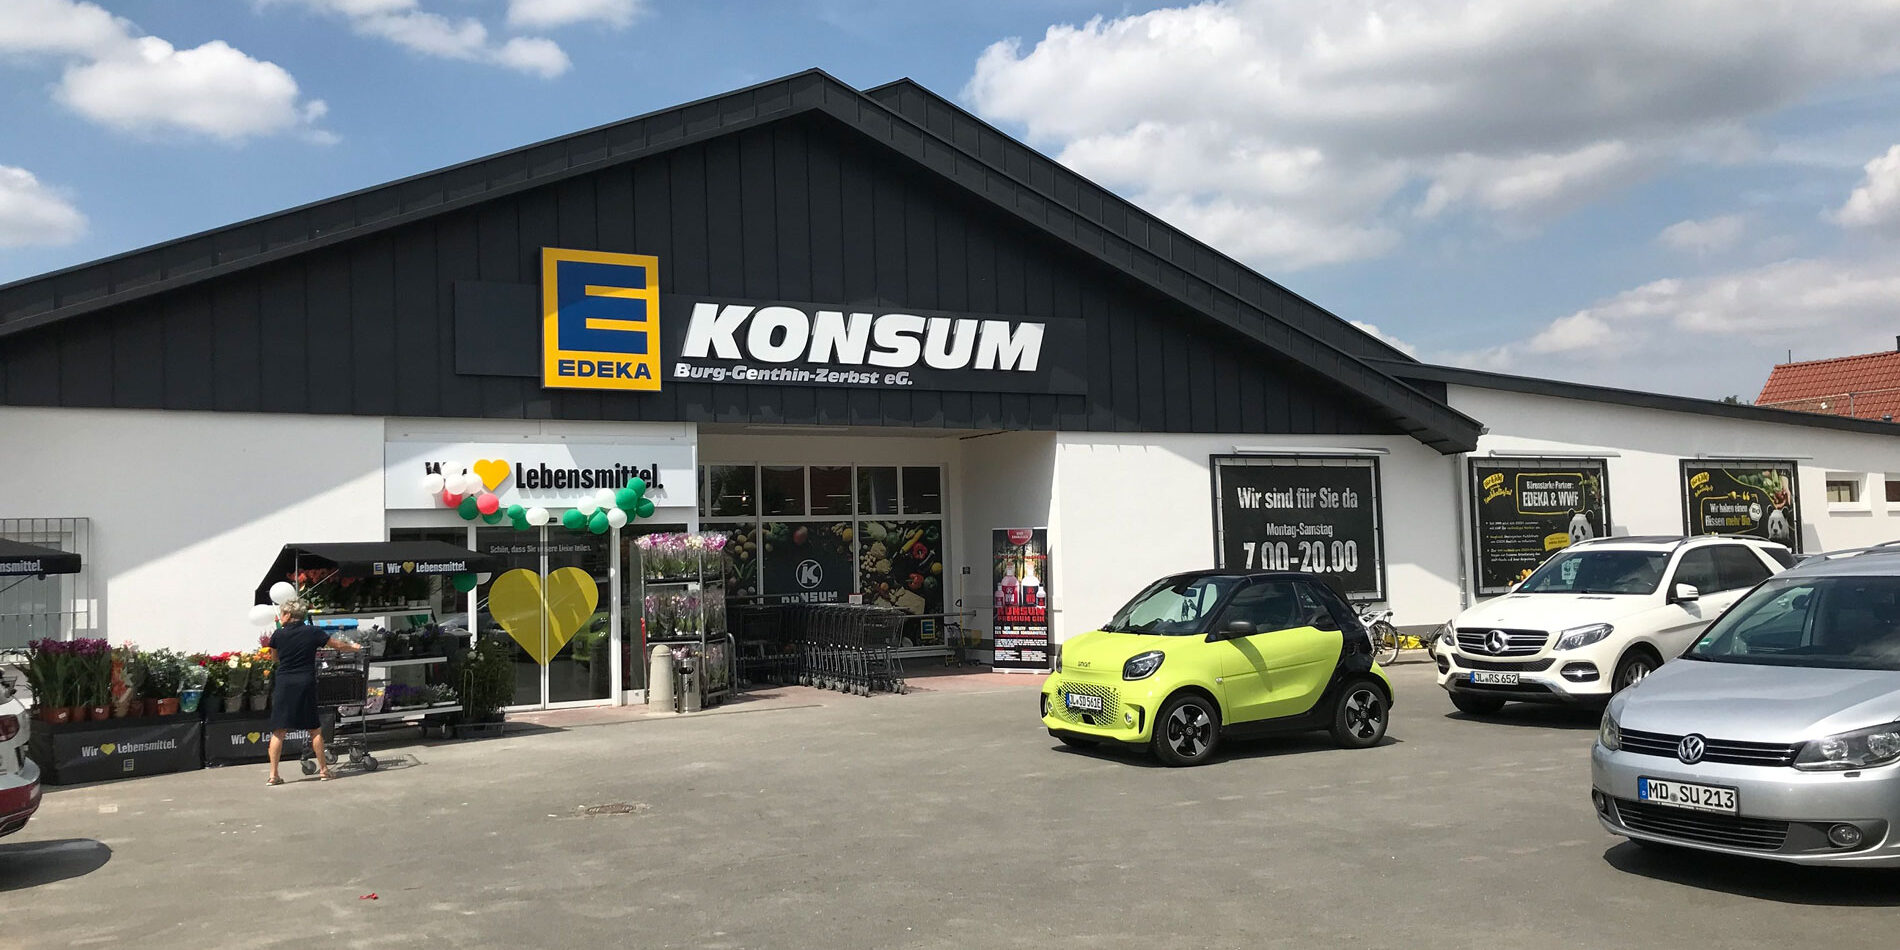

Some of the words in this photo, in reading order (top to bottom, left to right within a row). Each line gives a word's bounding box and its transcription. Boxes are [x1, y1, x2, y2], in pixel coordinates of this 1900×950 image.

[683, 303, 1046, 372] KONSUM
[557, 358, 652, 381] EDEKA
[674, 363, 880, 386] Burg-Genthin-Zerbst
[884, 372, 913, 386] eG.
[1236, 487, 1262, 509] Wir
[1264, 487, 1294, 509] sind
[1295, 487, 1317, 509] für
[1319, 487, 1340, 509] Sie
[1342, 487, 1358, 509] da
[1522, 492, 1549, 507] EDEKA
[1550, 492, 1557, 507] &
[1558, 491, 1579, 507] WWF
[1709, 503, 1719, 513] Wir
[1266, 523, 1334, 538] Montag-Samstag
[387, 563, 401, 574] Wir
[416, 560, 467, 573] Lebensmittel.
[1488, 673, 1500, 684] RS
[1501, 674, 1517, 684] 652
[82, 746, 98, 757] Wir
[117, 738, 177, 754] Lebensmittel.
[231, 734, 246, 745] Wir
[1648, 781, 1669, 800] MD
[1680, 785, 1700, 805] SU
[1703, 789, 1735, 809] 213
